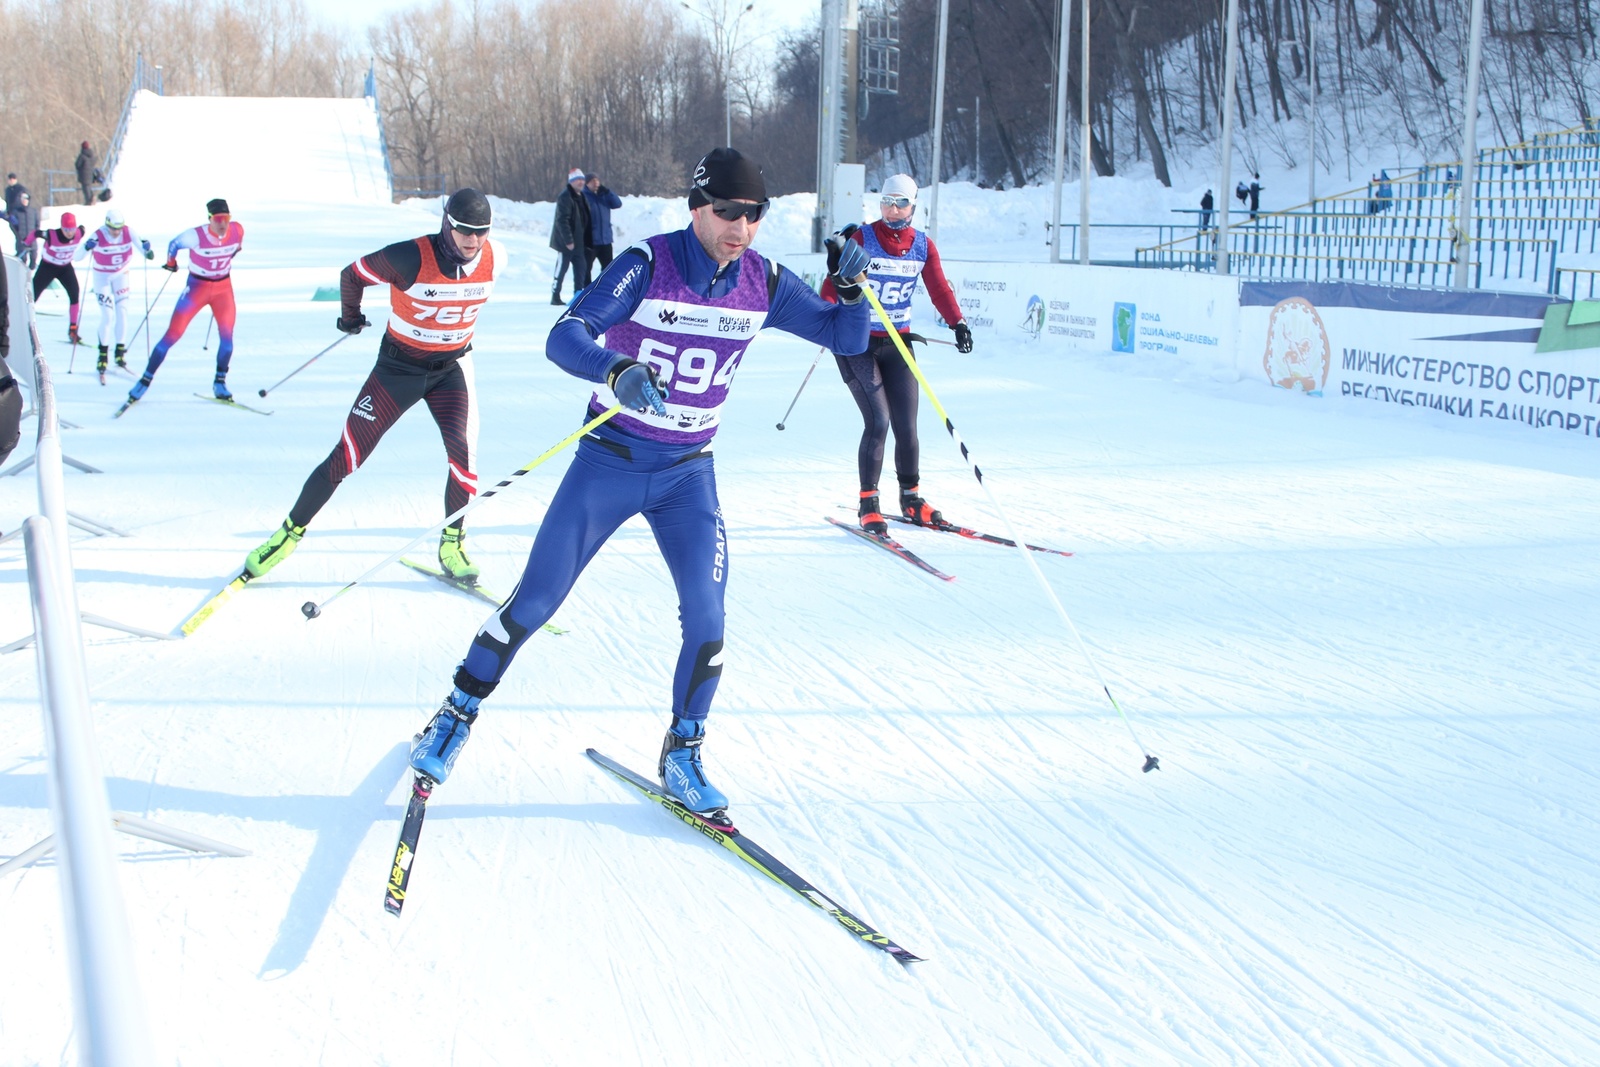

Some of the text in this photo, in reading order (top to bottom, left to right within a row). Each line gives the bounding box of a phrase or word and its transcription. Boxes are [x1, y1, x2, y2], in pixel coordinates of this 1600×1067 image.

[208, 256, 231, 270] 17
[612, 268, 636, 298] CRAFT
[412, 301, 480, 325] 769
[718, 316, 751, 326] RUSSIA
[1141, 312, 1161, 322] ФОНД
[636, 338, 742, 395] 594
[1342, 347, 1600, 405] МИНИСТЕРСТВО СПОРТ
[713, 518, 725, 583] CRAFT
[664, 754, 702, 807] SPINE
[661, 800, 725, 845] FISCHER
